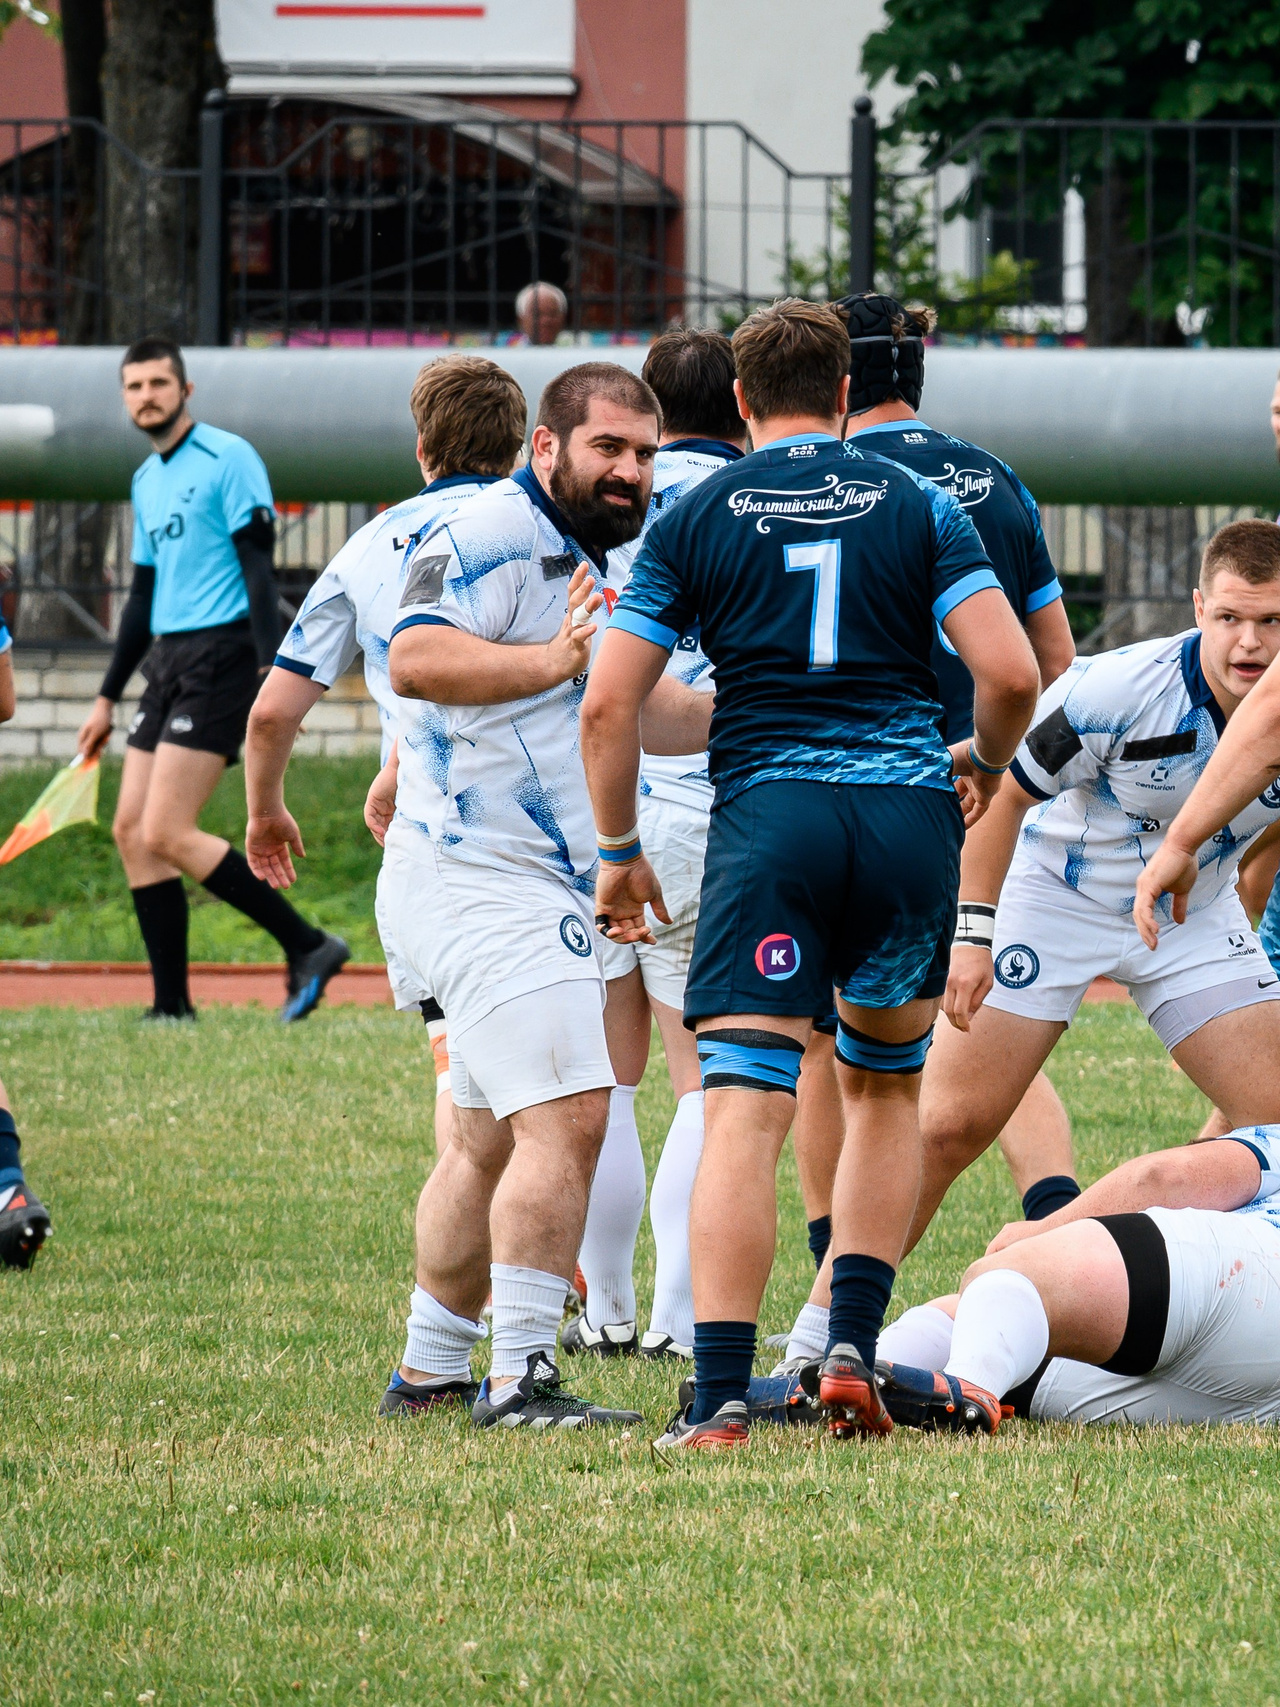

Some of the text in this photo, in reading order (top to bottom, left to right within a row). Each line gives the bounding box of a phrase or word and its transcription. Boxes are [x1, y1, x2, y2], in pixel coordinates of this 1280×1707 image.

[783, 538, 841, 672] 7
[1135, 781, 1176, 791] centurion
[771, 949, 787, 966] K
